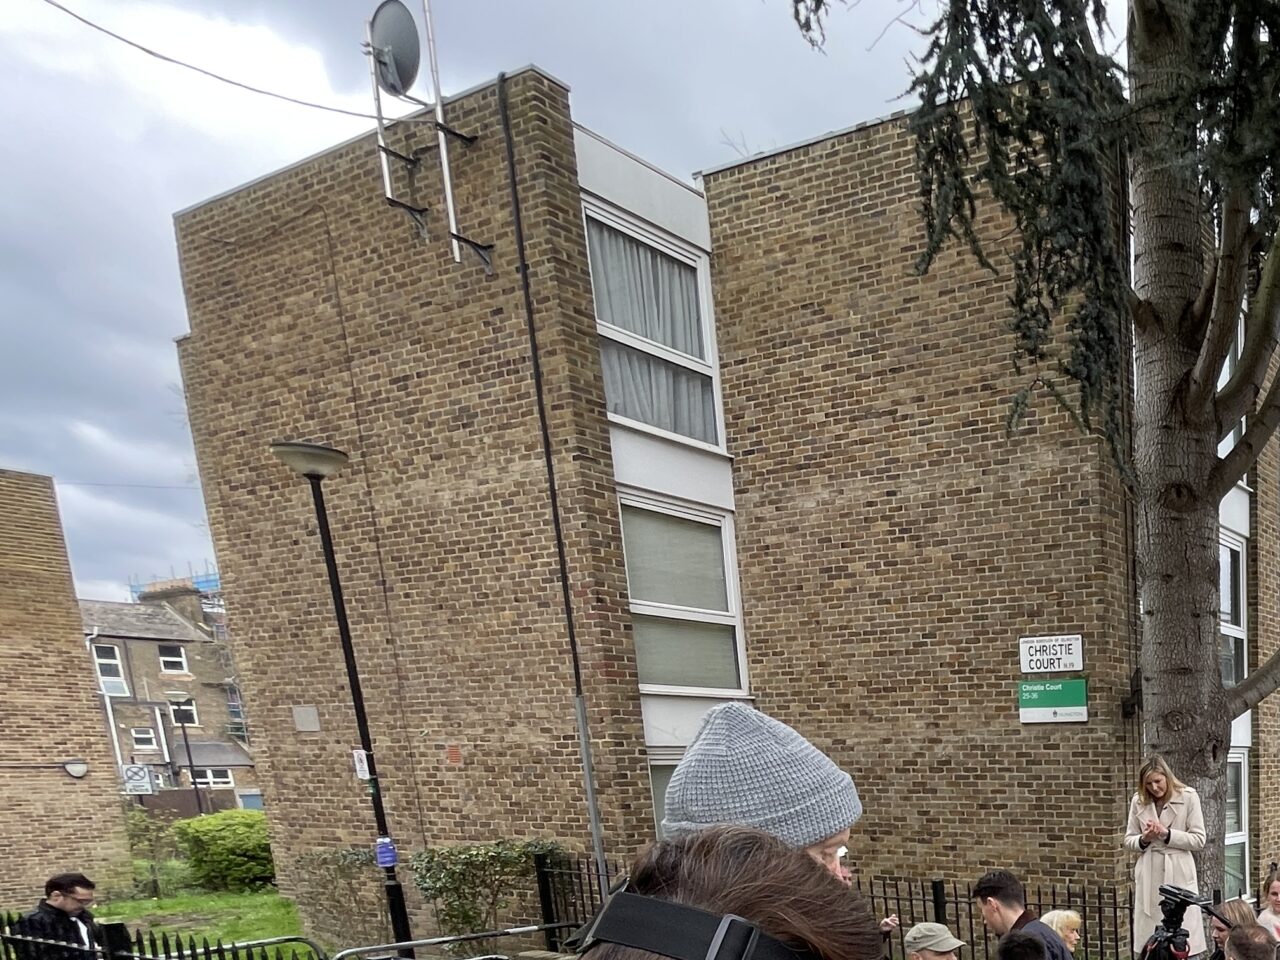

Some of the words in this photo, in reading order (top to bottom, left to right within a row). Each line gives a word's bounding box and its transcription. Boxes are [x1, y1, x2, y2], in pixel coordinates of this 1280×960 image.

[1028, 643, 1073, 657] CHRISTIE
[1028, 657, 1062, 670] COURT
[1022, 684, 1045, 692] Christie
[1045, 683, 1062, 691] Court
